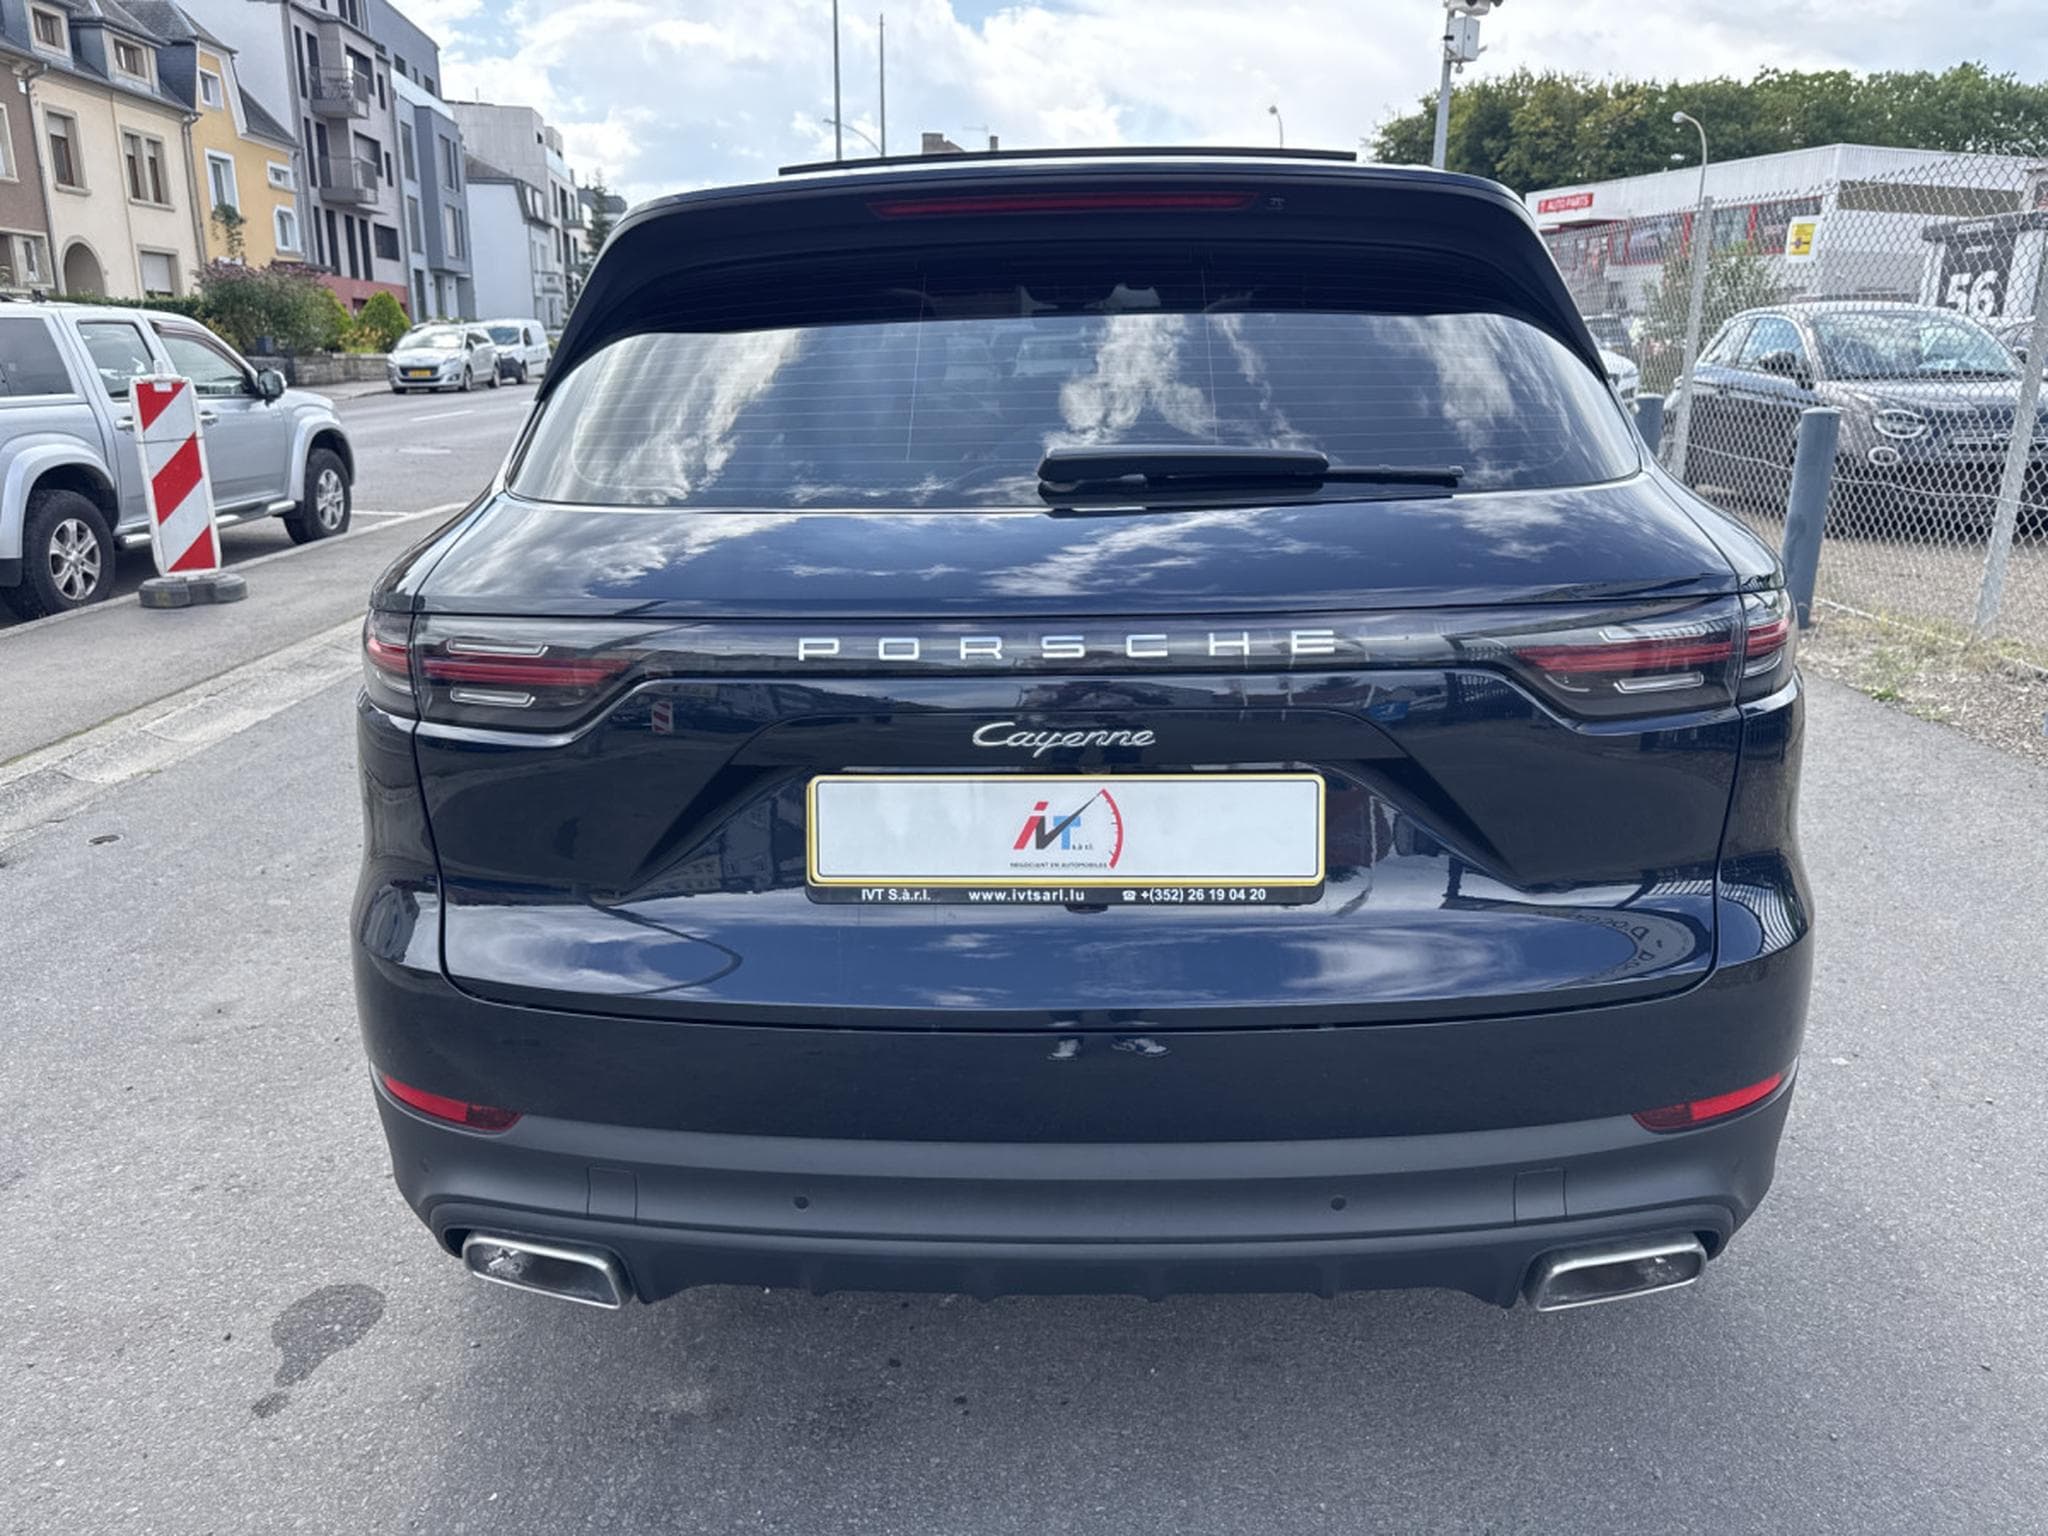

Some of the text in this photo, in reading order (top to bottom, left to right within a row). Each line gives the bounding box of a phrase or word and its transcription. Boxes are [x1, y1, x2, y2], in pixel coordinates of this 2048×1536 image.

[1945, 270, 1999, 319] 56
[798, 629, 1335, 661] PORSCHE
[972, 721, 1156, 759] Cayenne
[861, 888, 885, 901] IVT
[968, 888, 1085, 901] www.ivtsarl.lu
[1141, 887, 1184, 903] +(352)
[1187, 888, 1205, 901] 26
[1208, 888, 1225, 901] 19
[1228, 888, 1246, 901] 04
[1249, 888, 1267, 901] 20
